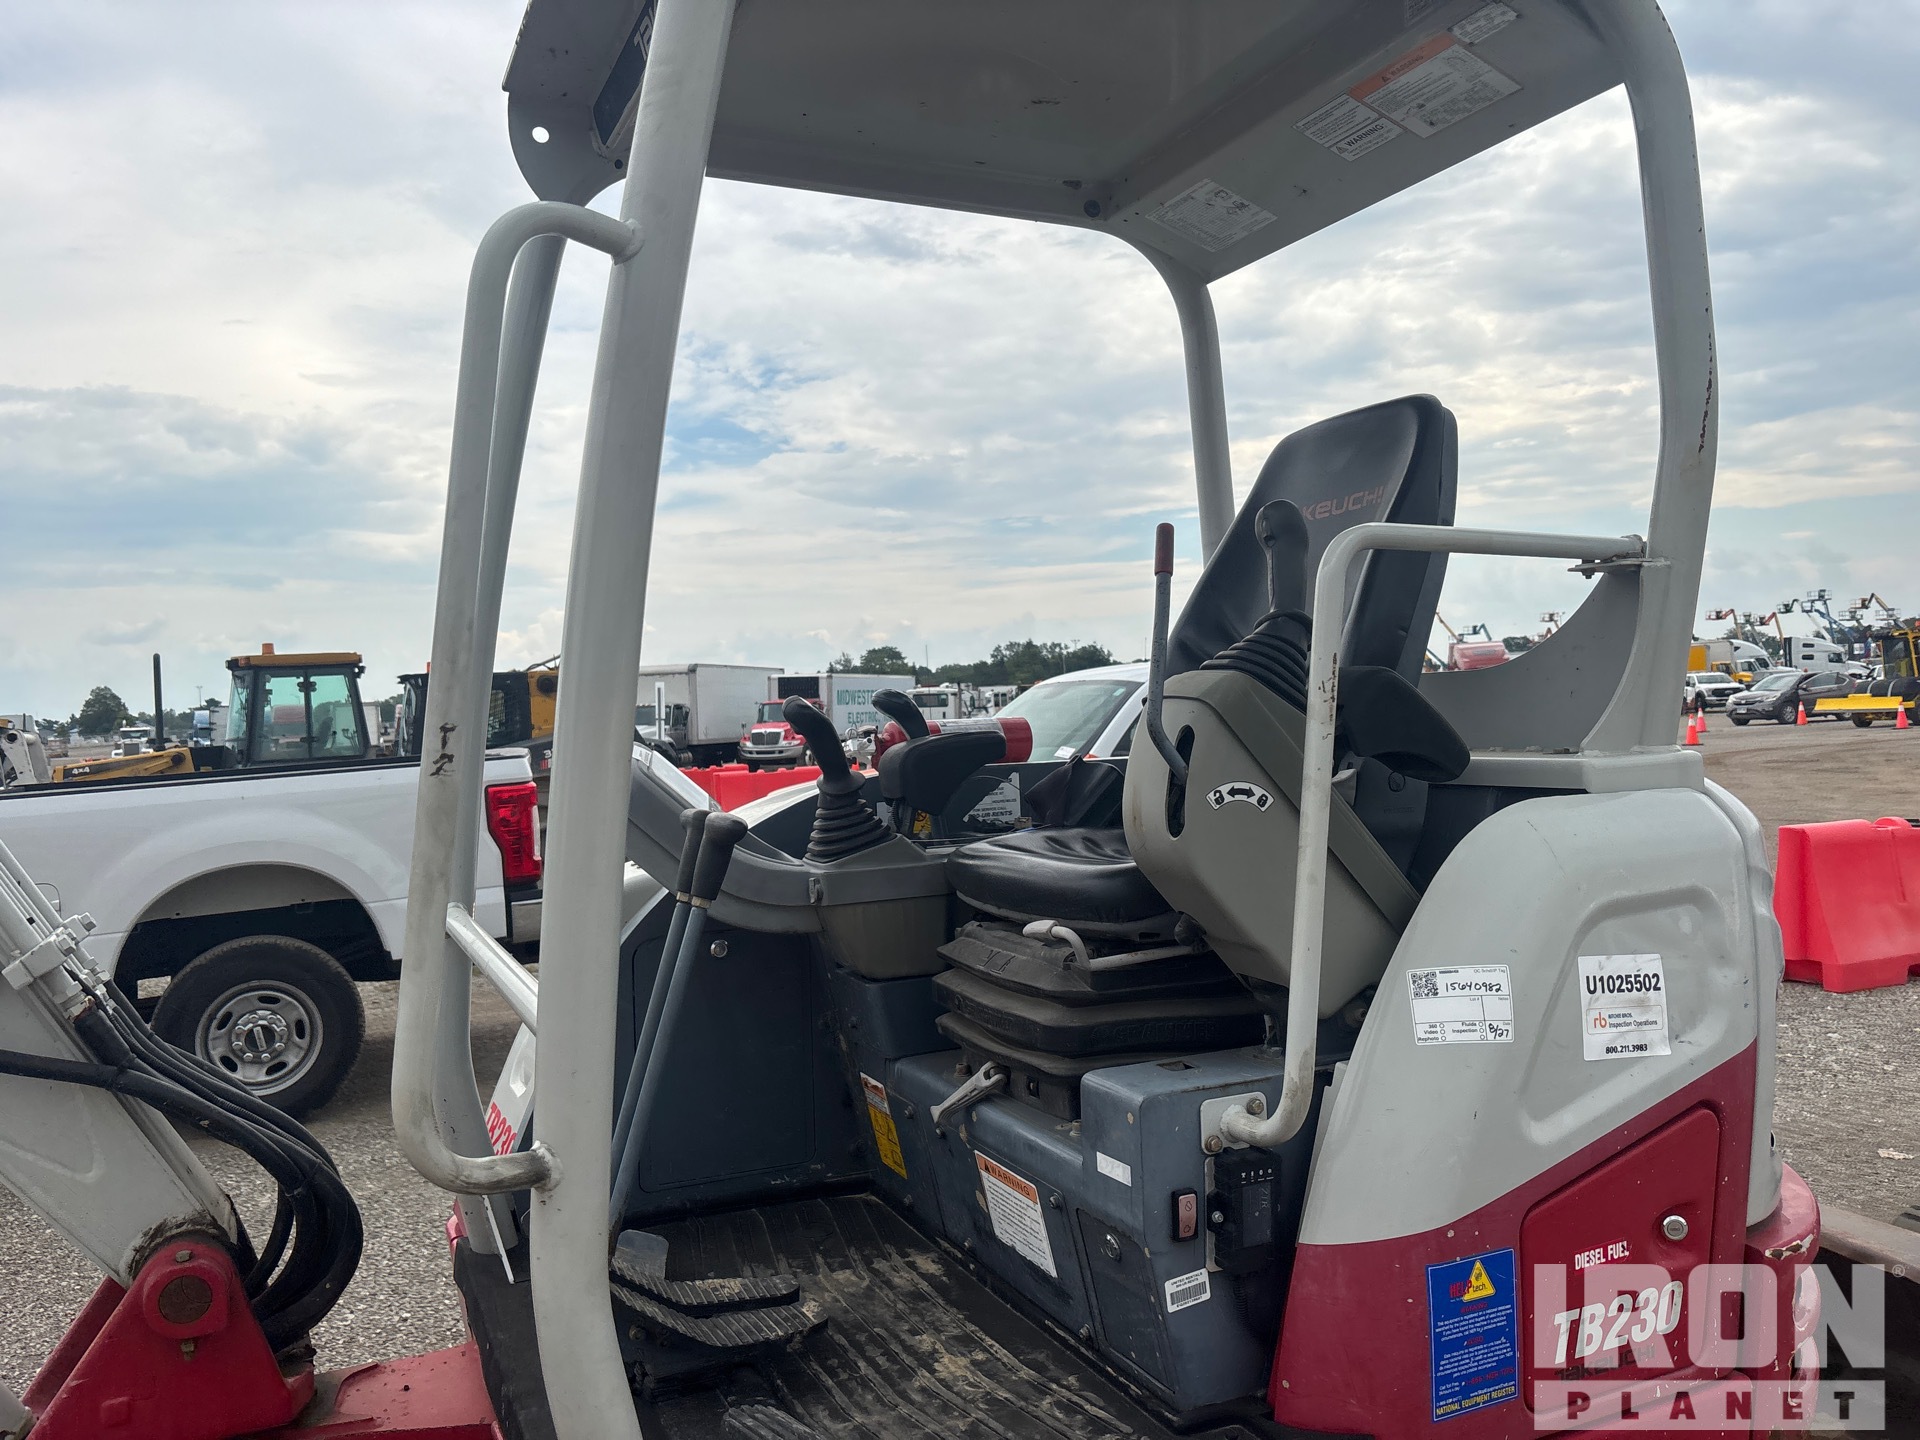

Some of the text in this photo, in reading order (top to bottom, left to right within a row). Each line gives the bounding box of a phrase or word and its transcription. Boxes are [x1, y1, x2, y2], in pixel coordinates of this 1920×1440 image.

[1344, 123, 1384, 147] WARNING
[1303, 486, 1384, 520] KEUCHI
[1445, 981, 1503, 992] 15640982
[1585, 973, 1661, 994] U1025502
[1594, 1011, 1607, 1028] rb
[1608, 1019, 1658, 1029] Inspection Operations
[1605, 1043, 1648, 1054] 800.211.3983
[989, 1164, 1030, 1197] WARNING
[1574, 1241, 1630, 1270] DIESEL FUEL
[1450, 1280, 1472, 1297] HELP
[1554, 1280, 1684, 1365] TB230
[1436, 1386, 1514, 1415] NATIONAL EQUIPMENT REGISTER
